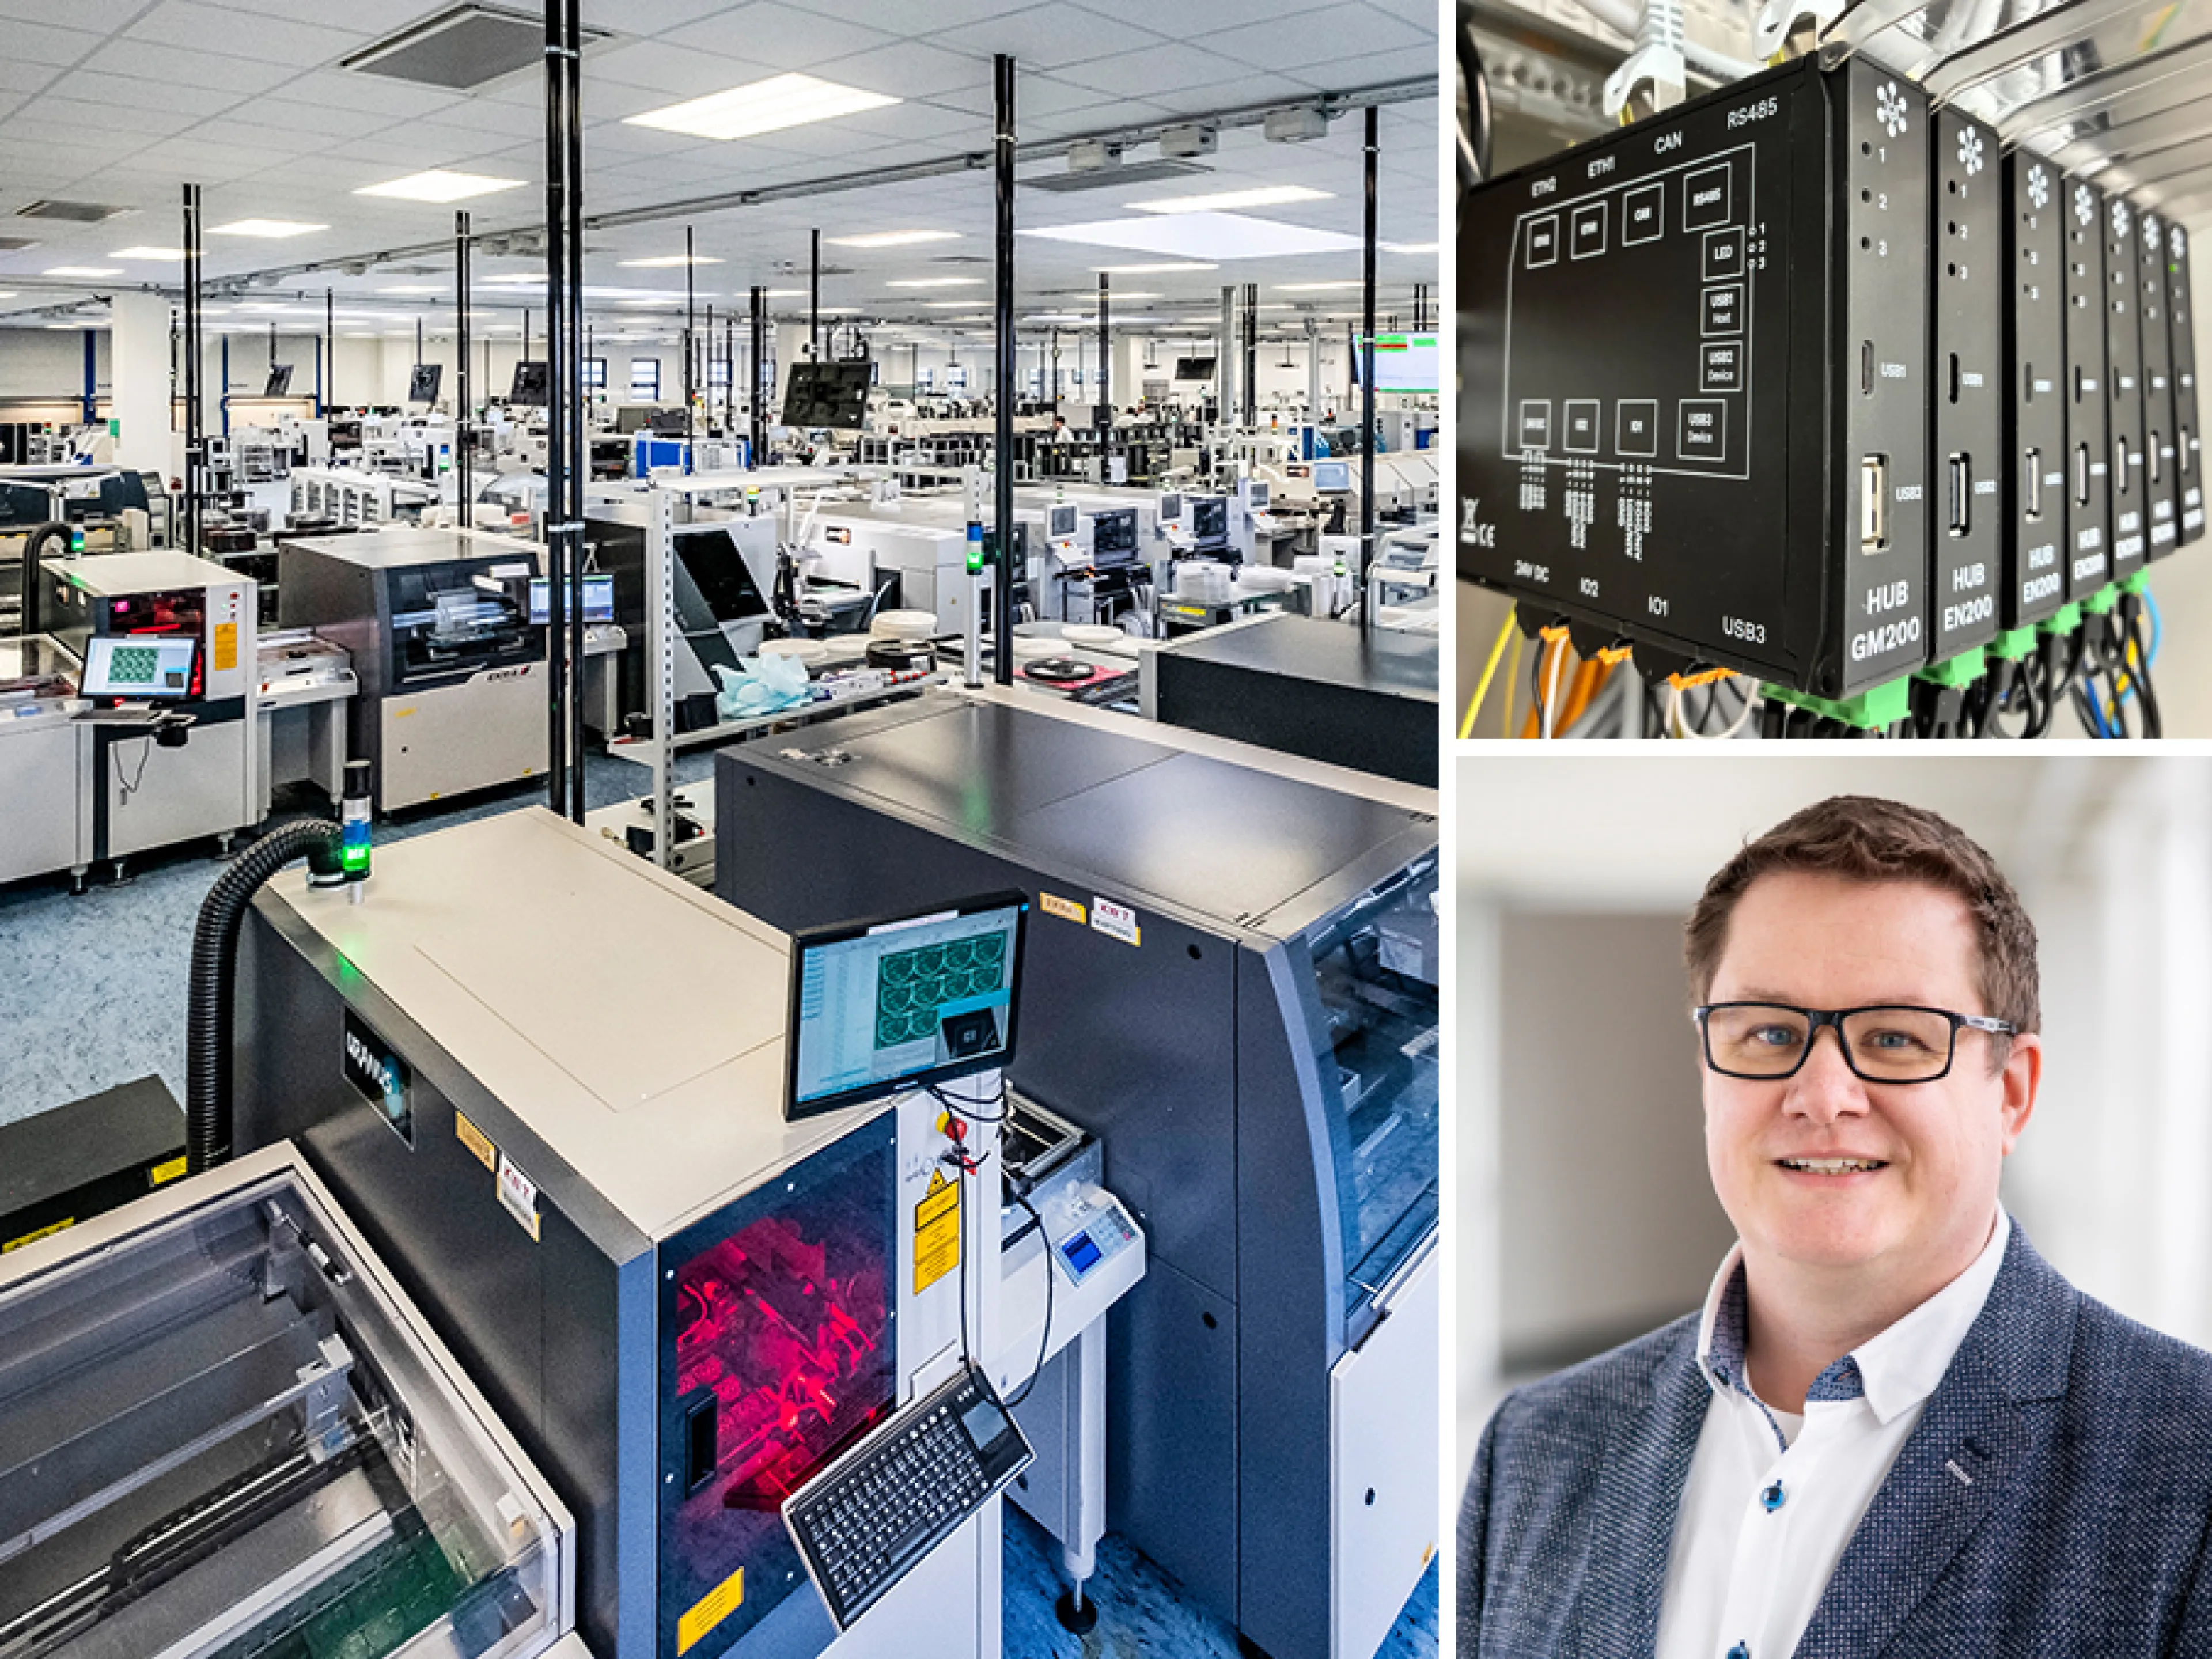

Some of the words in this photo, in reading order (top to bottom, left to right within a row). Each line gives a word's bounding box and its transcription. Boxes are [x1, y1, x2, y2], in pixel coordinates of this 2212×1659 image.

[1727, 97, 1777, 130] RS485
[1654, 131, 1681, 154] CAN
[1878, 147, 1885, 162] 1
[1878, 193, 1887, 211] 2
[1759, 222, 1765, 235] 1
[1759, 239, 1765, 252] 2
[1759, 256, 1765, 270] 3
[1952, 562, 1985, 592] HUB
[1649, 596, 1667, 617] IO1
[1866, 579, 1909, 615] HUB
[1945, 594, 1993, 632] EN200
[1722, 616, 1765, 644] USB3
[1851, 616, 1919, 661] GM200
